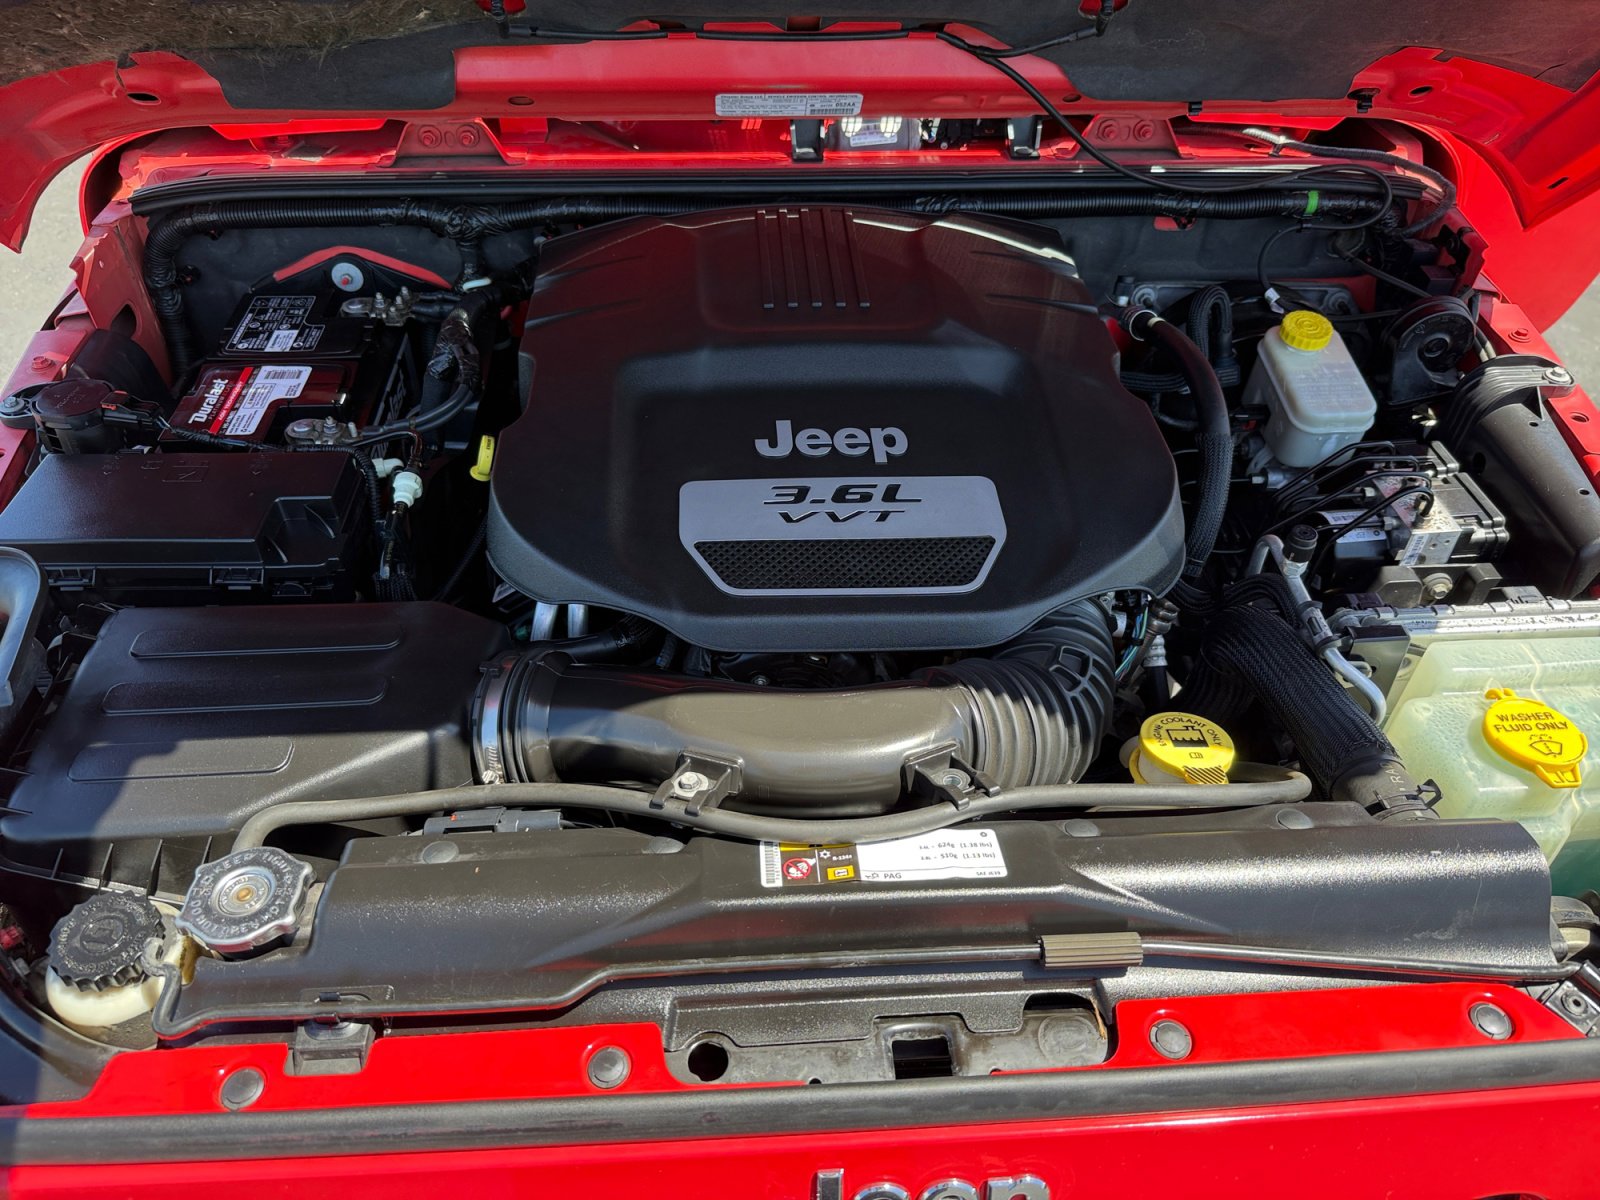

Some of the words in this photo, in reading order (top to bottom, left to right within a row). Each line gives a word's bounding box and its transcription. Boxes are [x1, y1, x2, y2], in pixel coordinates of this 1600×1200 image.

[187, 378, 229, 424] Duralast
[754, 419, 909, 465] Jeep
[763, 483, 922, 505] 3.6L
[777, 510, 906, 524] VVT
[1160, 716, 1207, 728] COOLANT
[1496, 711, 1555, 723] WASHER
[1153, 724, 1168, 747] ENGINE
[1494, 723, 1533, 733] FLUID
[1535, 721, 1569, 731] ONLY
[1206, 728, 1223, 747] ONLY
[213, 851, 257, 874] KEEP
[261, 851, 292, 873] TIGHT
[190, 899, 203, 916] DO
[196, 914, 219, 934] NOT
